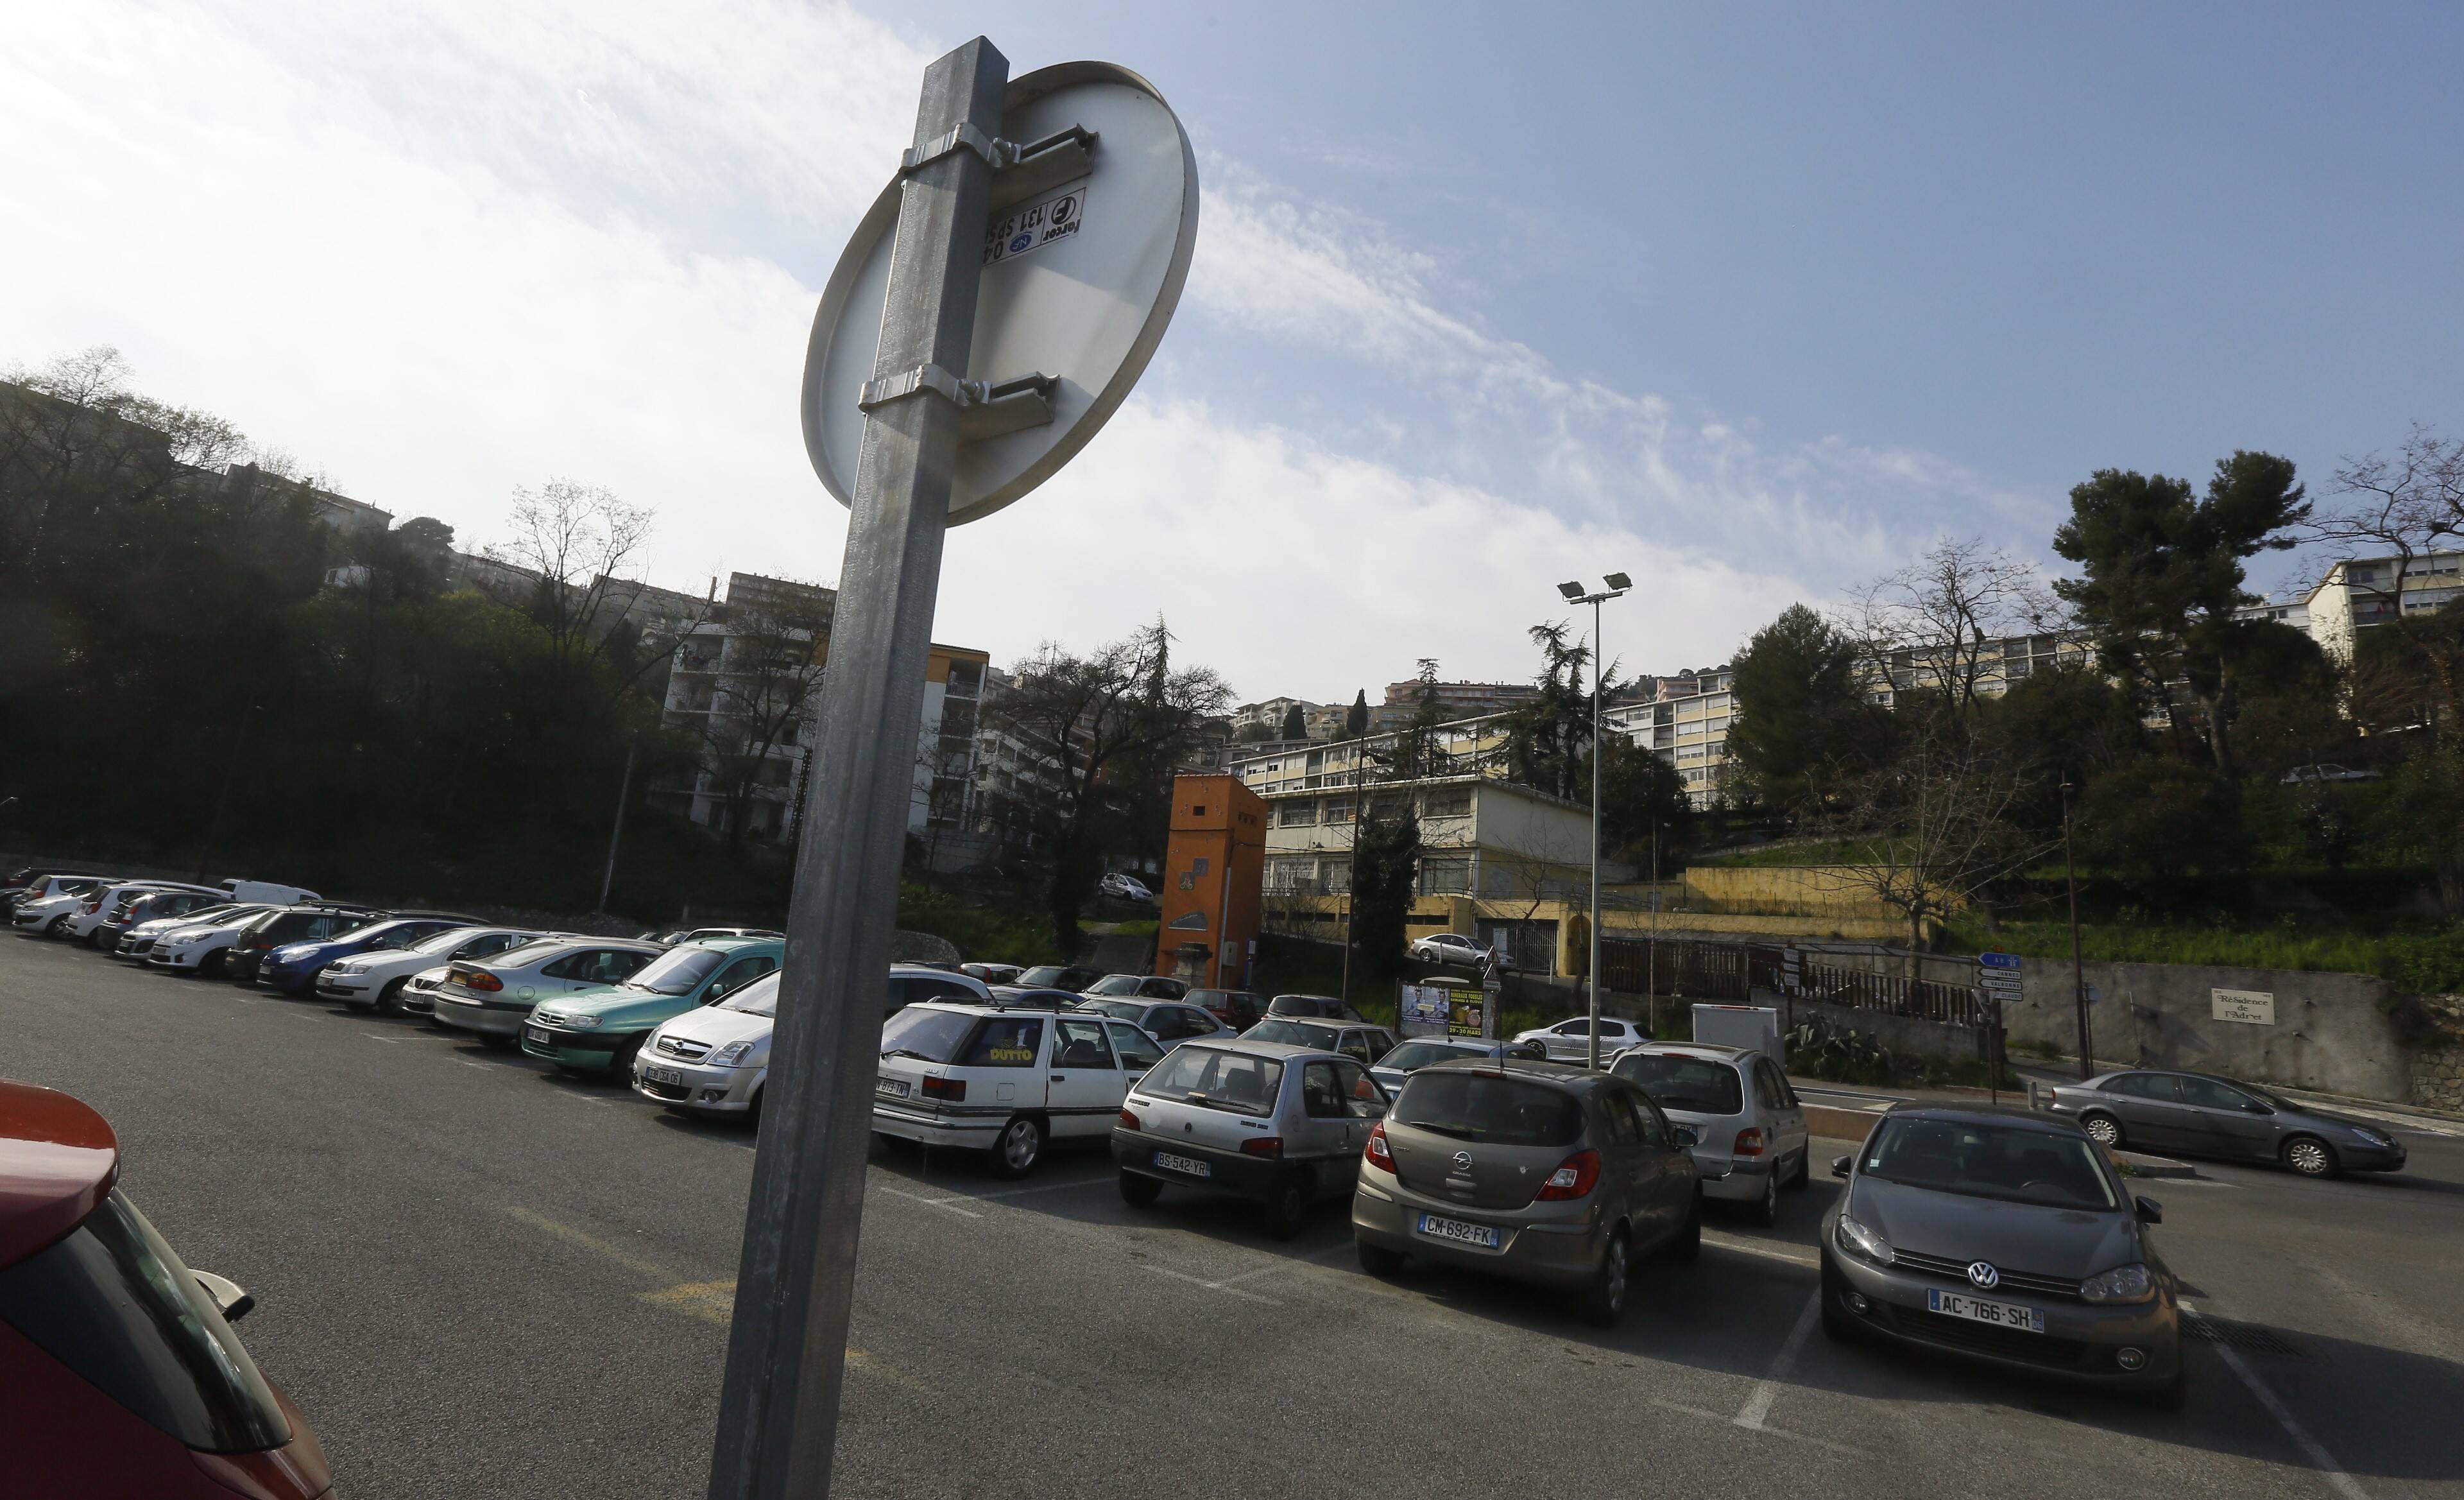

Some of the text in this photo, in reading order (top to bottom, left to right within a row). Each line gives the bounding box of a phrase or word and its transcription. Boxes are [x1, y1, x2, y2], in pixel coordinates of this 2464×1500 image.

[1020, 207, 1043, 232] 131
[990, 1048, 1032, 1060] DUTTO
[1427, 1218, 1491, 1244] CM-692-FK
[1943, 1295, 2030, 1327] AC-766-SH
[2032, 1320, 2042, 1329] 06
